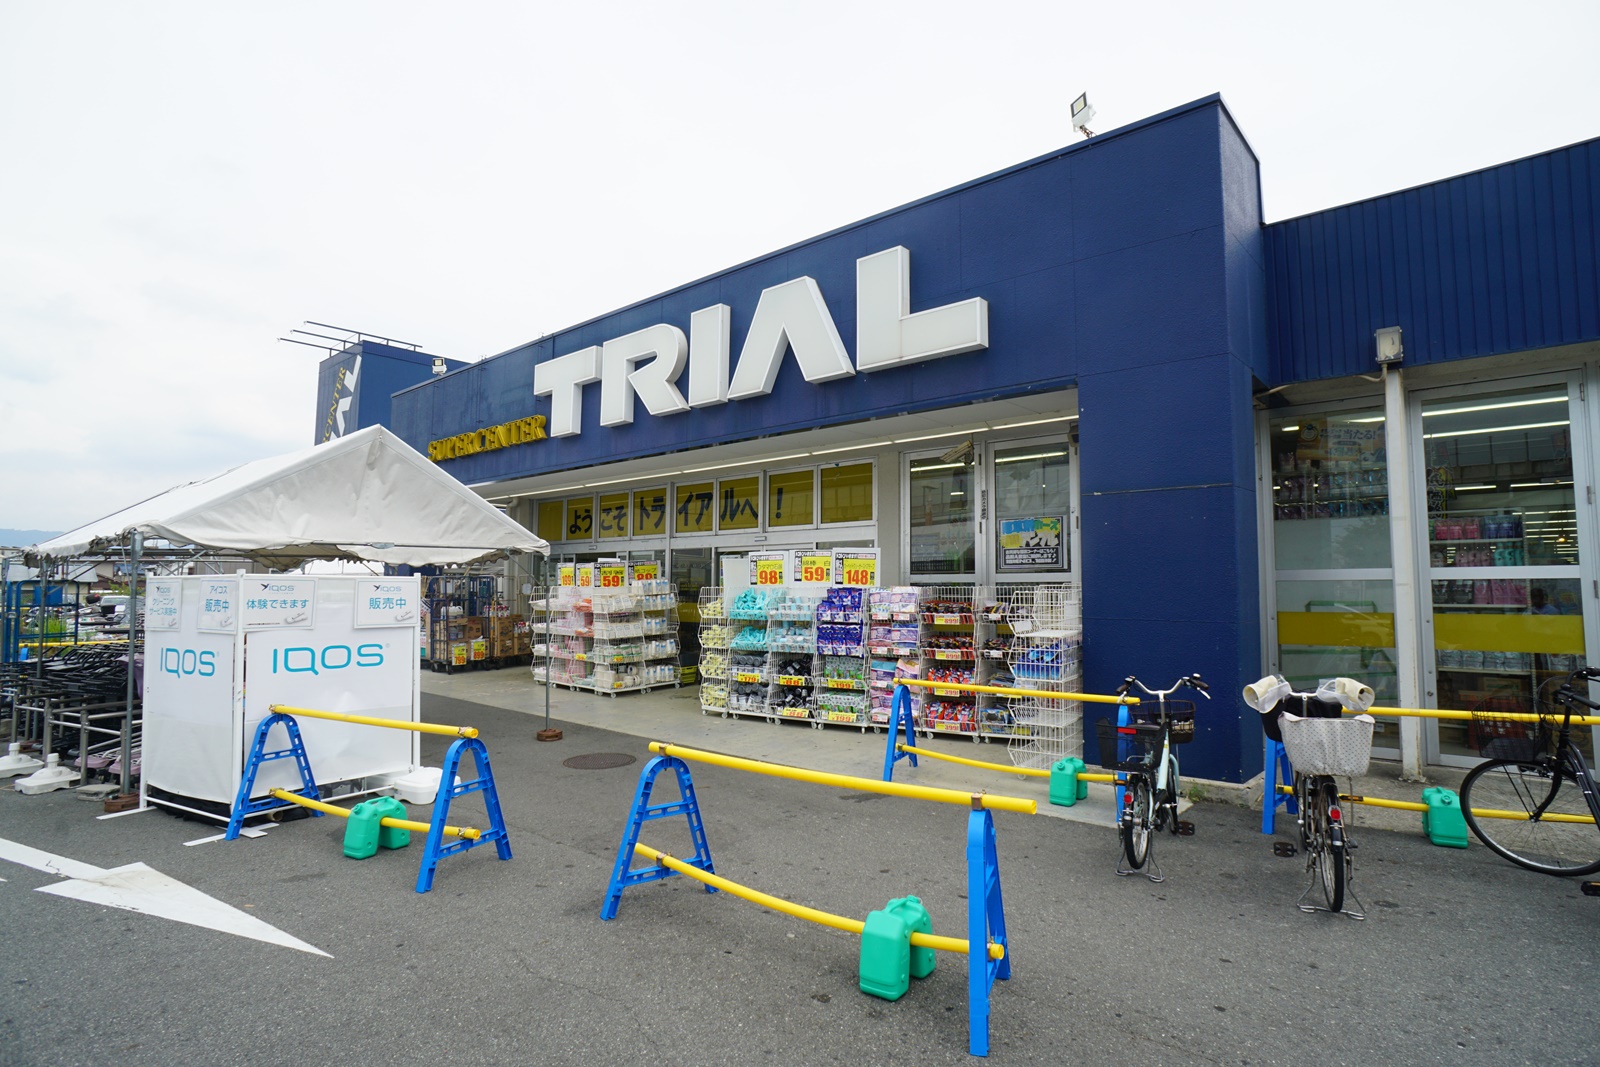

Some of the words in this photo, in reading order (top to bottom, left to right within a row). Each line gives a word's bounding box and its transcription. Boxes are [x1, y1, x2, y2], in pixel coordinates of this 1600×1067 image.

[534, 245, 988, 438] TRIAL
[759, 570, 778, 584] 98
[804, 567, 825, 581] 59
[846, 570, 868, 585] 148
[268, 584, 295, 593] IQOS
[603, 576, 620, 587] 59
[209, 585, 228, 594] アイコス
[380, 585, 402, 593] IQOS
[205, 599, 229, 613] 販売中
[246, 599, 309, 610] 体験できます
[369, 597, 407, 610] 販売中
[160, 647, 216, 679] IQOS
[273, 643, 384, 676] IQOS
